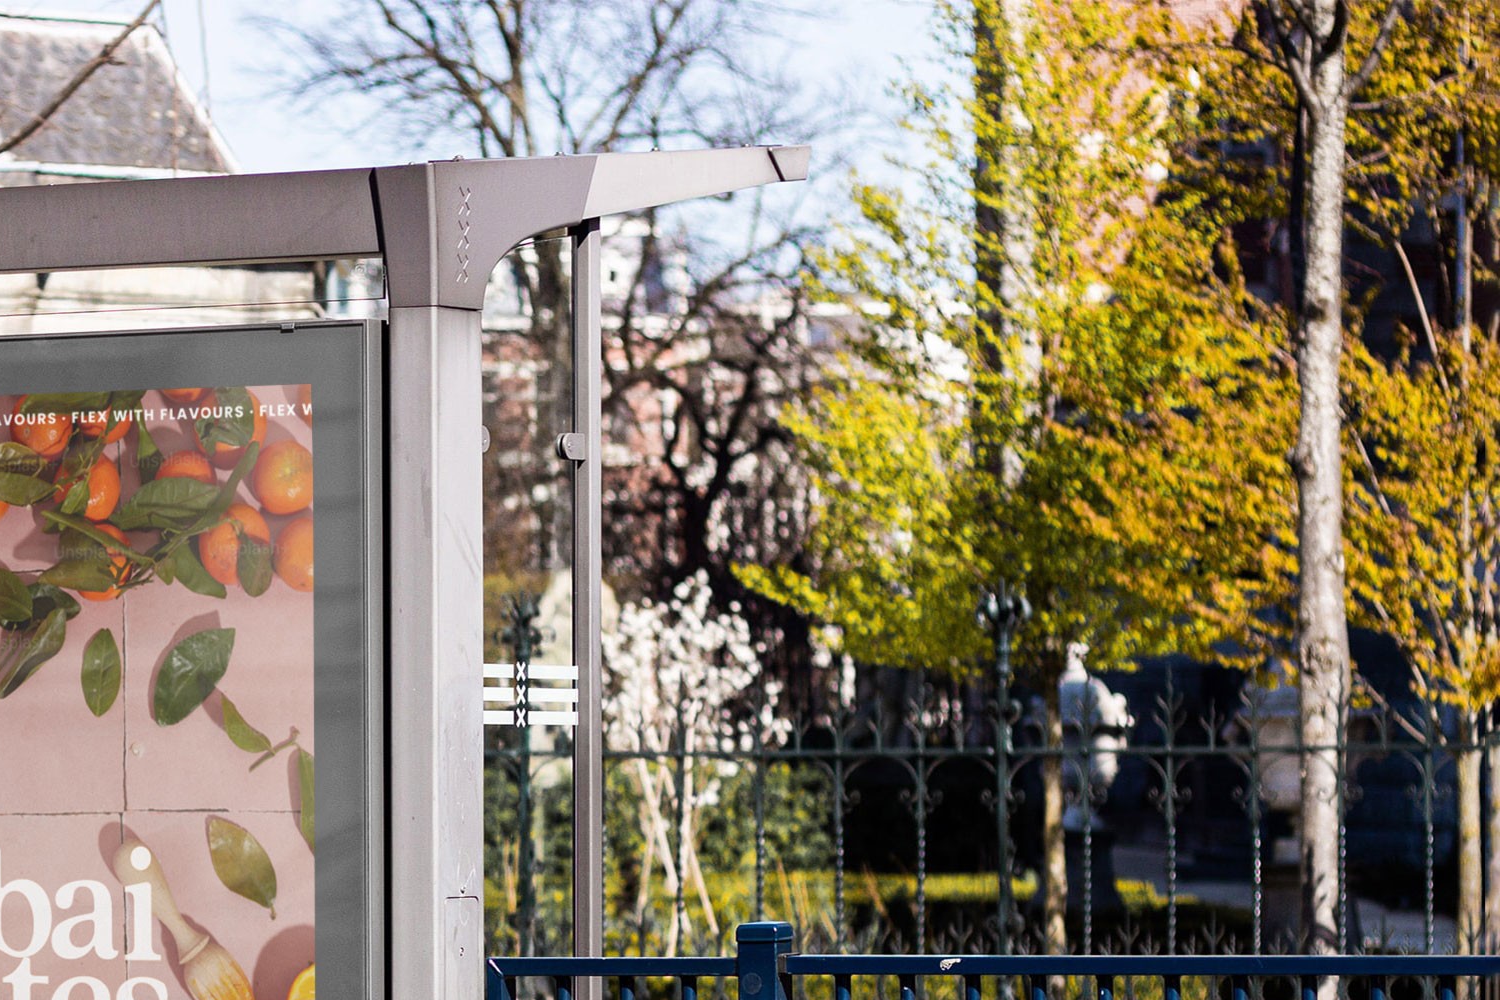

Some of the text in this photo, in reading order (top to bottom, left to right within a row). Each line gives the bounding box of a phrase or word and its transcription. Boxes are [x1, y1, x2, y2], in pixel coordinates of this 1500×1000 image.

[72, 411, 106, 423] FLEX
[113, 409, 154, 422] WITH
[159, 405, 244, 421] FLAVOURS
[259, 404, 296, 418] FLEX
